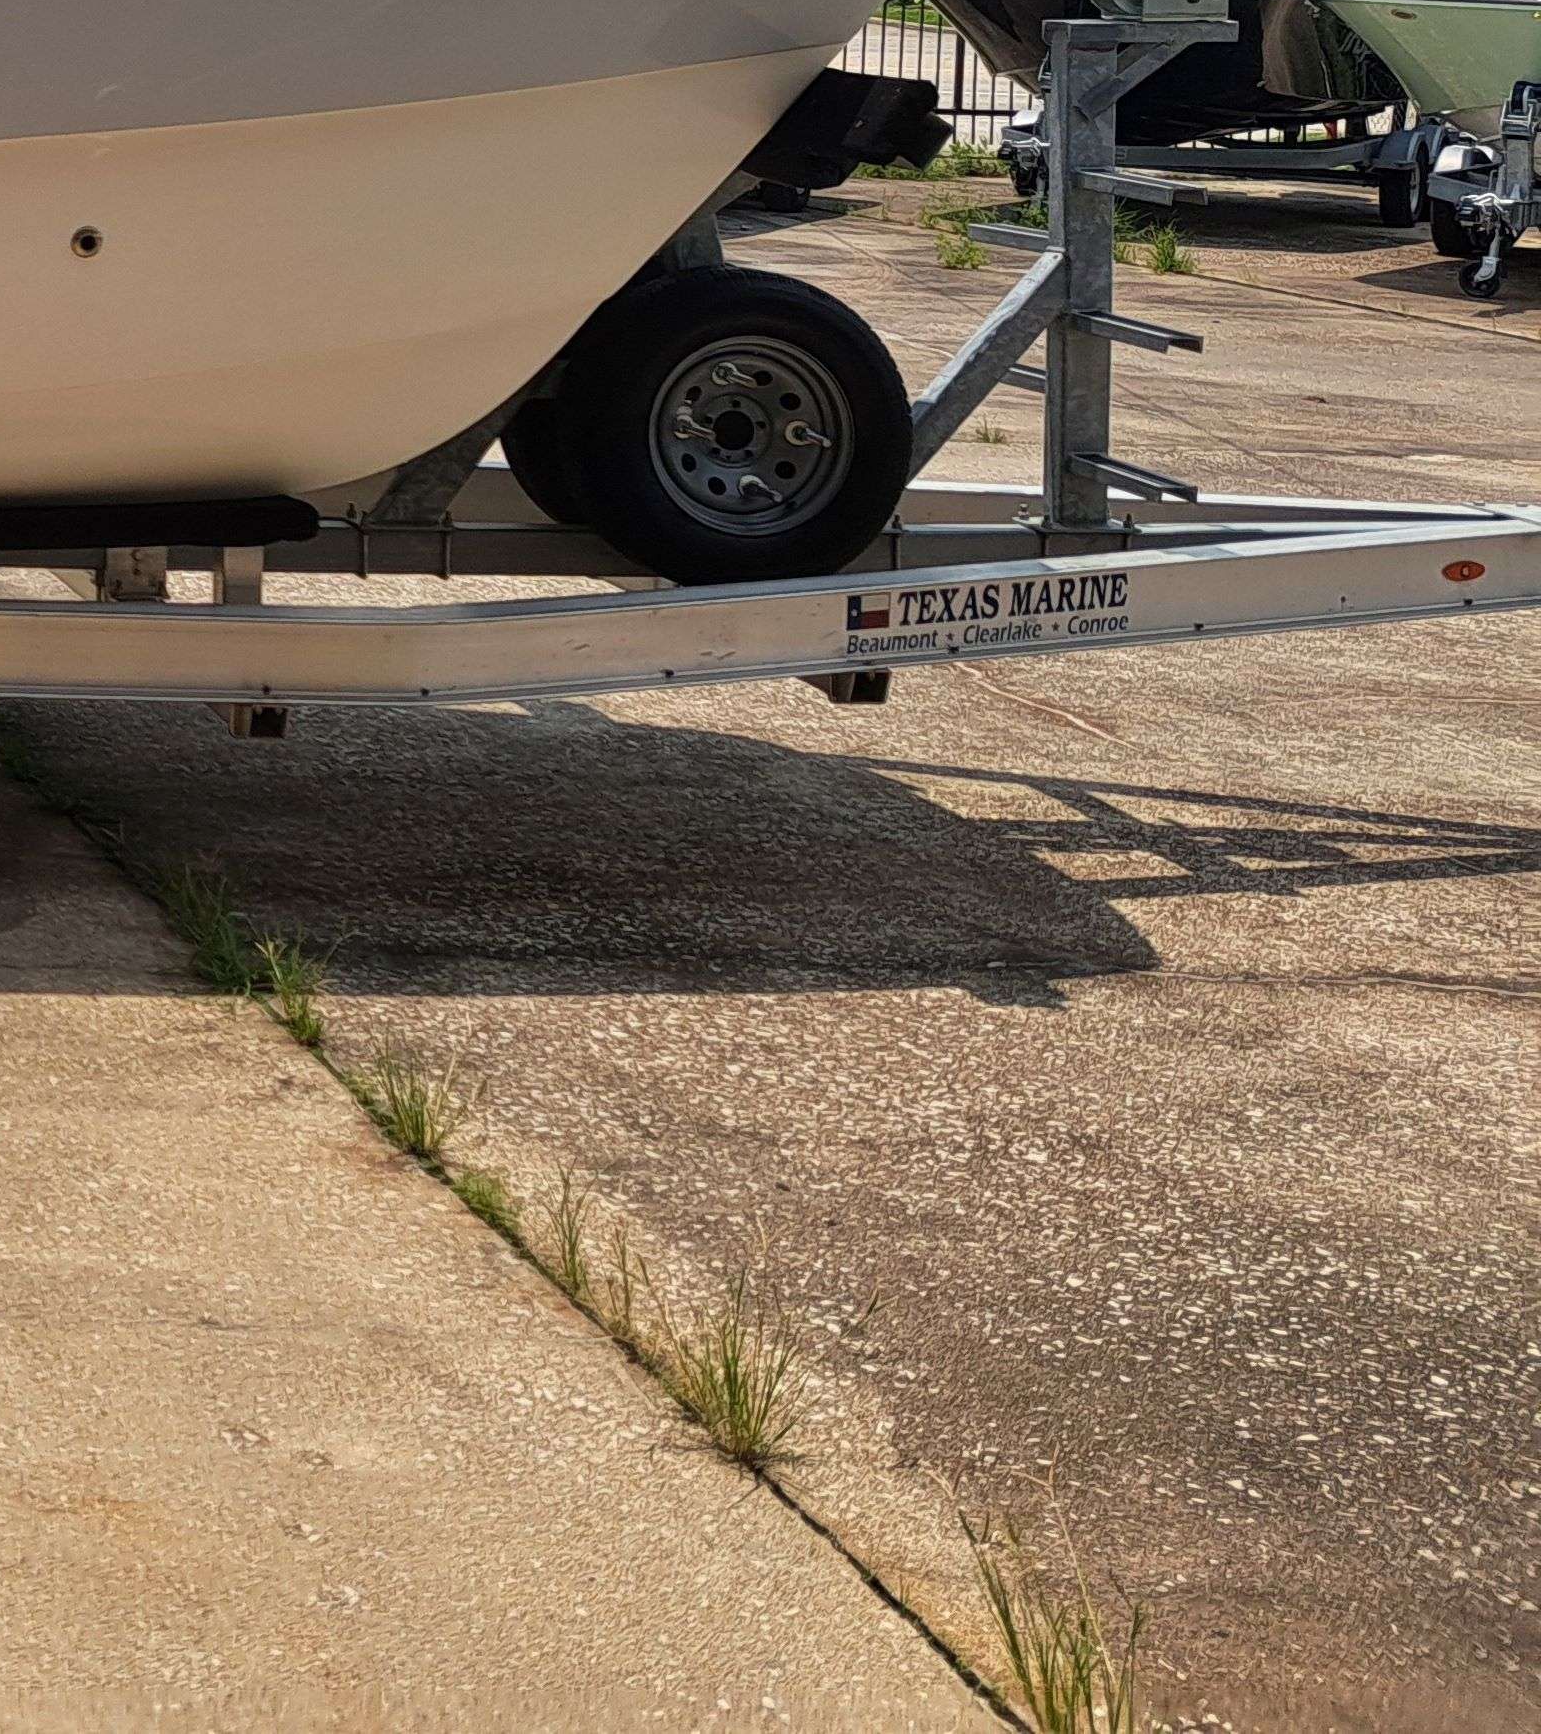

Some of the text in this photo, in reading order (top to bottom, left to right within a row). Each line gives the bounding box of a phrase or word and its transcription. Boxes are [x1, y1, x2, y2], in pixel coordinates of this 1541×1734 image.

[897, 572, 1129, 627] TEXAS MARINE
[846, 614, 1129, 655] Beaumont Clearlake Conroe
